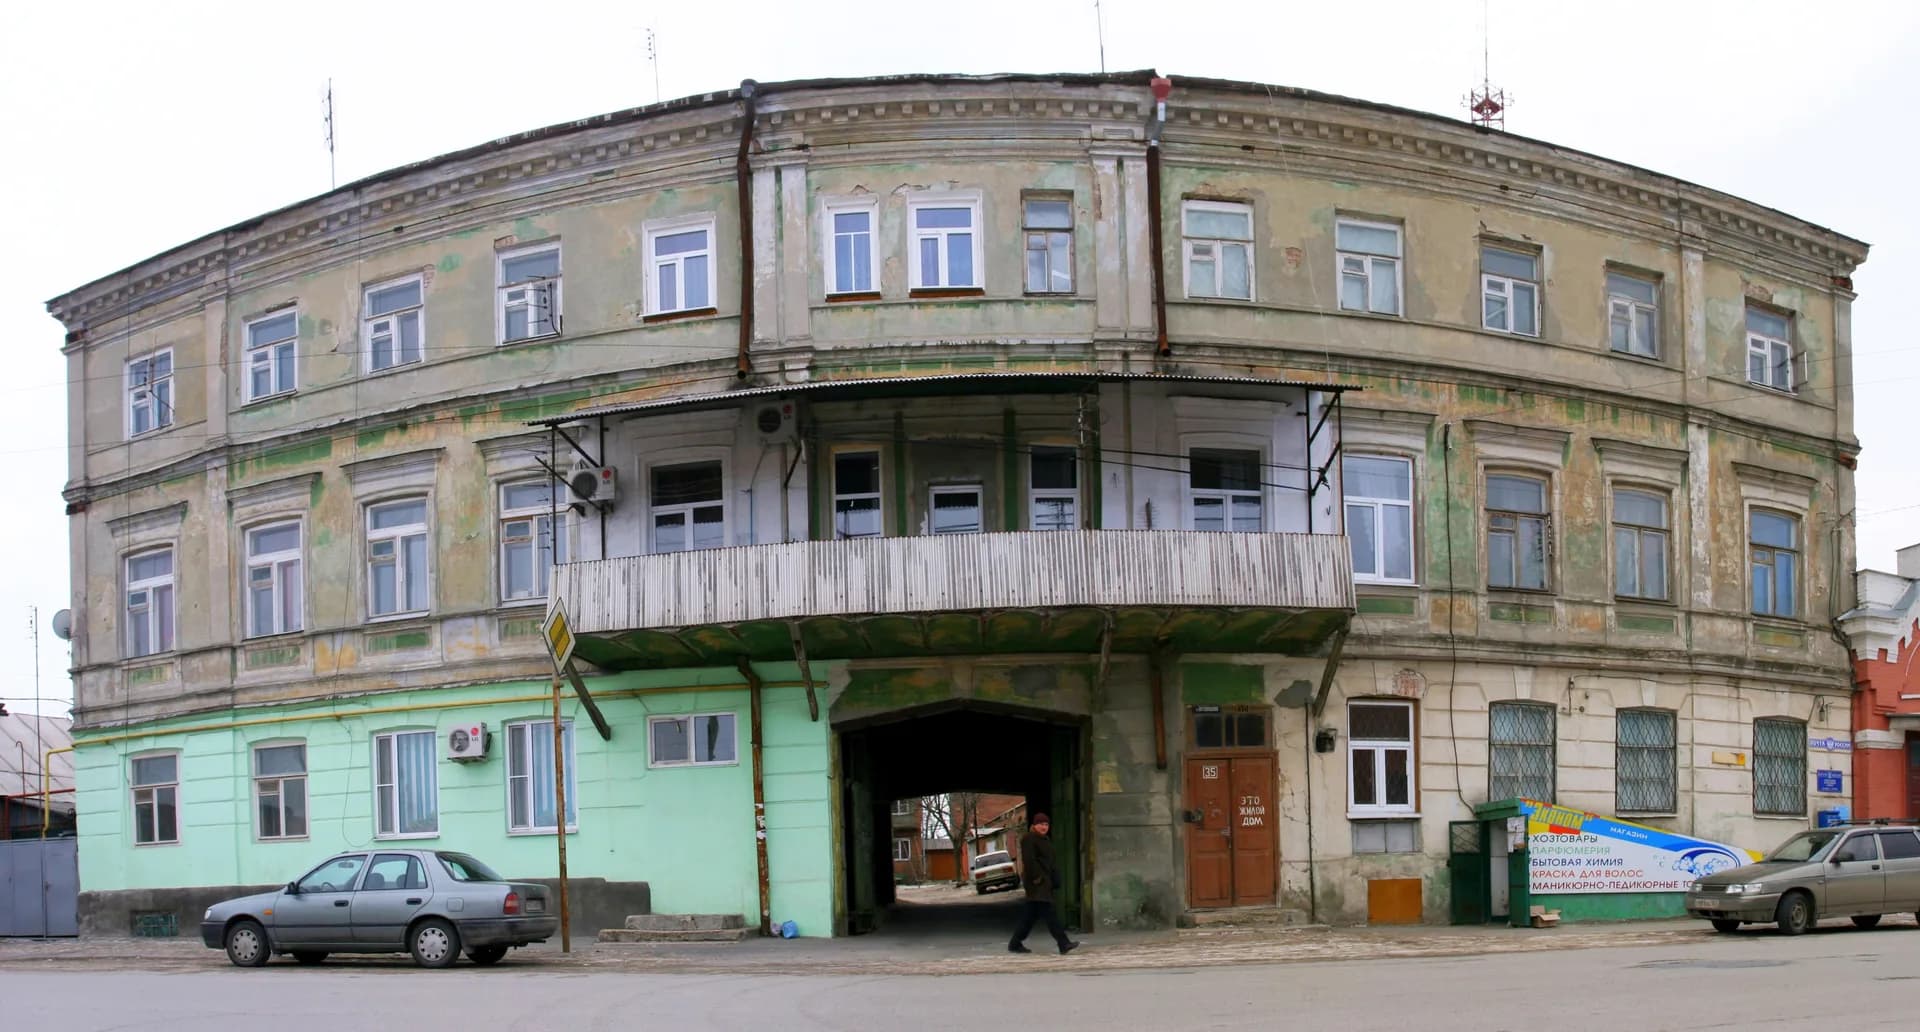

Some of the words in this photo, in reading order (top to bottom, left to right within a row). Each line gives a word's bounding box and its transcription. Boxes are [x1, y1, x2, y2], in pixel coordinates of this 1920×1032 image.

[1205, 767, 1216, 777] 35
[1240, 796, 1260, 805] ЭТО
[1239, 805, 1265, 816] ЖИЛОЙ
[1242, 816, 1263, 826] ДОМ
[1609, 826, 1648, 840] МАГАЗИН
[1531, 834, 1598, 843] ХОЗТОВАРЫ
[1532, 846, 1610, 855] ПАРФЮМЕРИЯ
[1532, 858, 1581, 867] БЫТОВАЯ
[1585, 858, 1623, 867] ХИМИЯ
[1532, 869, 1575, 878] КРАСКА
[1579, 869, 1602, 878] ДЛЯ
[1605, 869, 1644, 878] ВОЛОС
[1532, 880, 1678, 890] МАНИКЮРНО-ПЕДИКЮРНЫЕ
